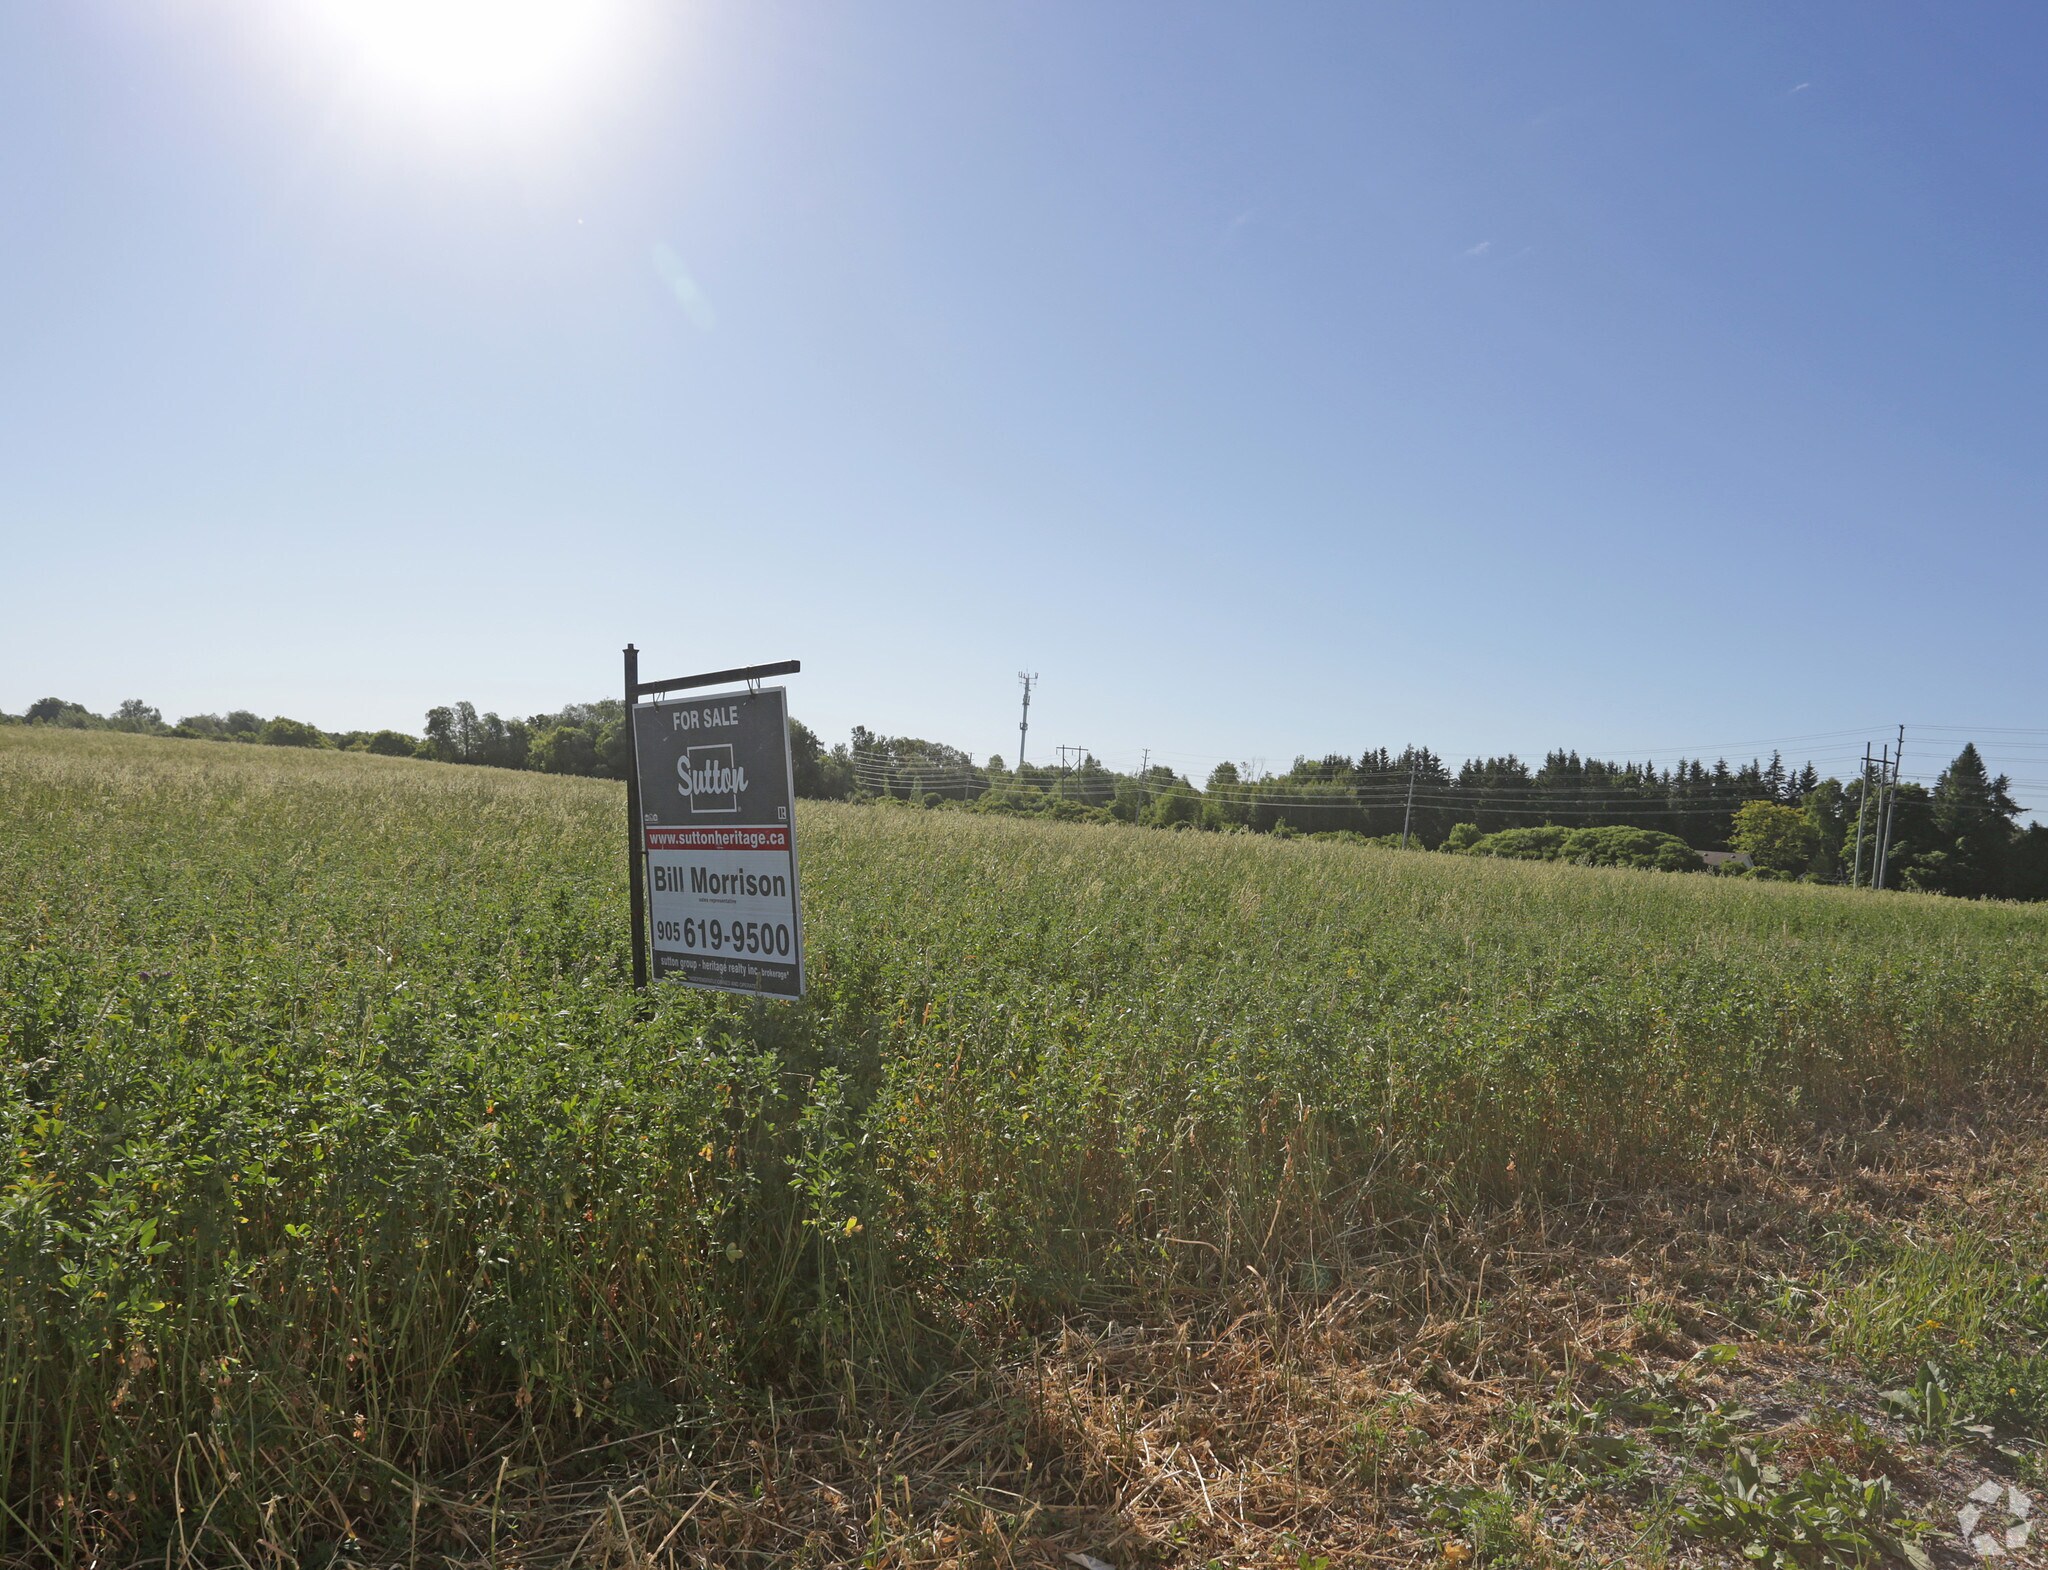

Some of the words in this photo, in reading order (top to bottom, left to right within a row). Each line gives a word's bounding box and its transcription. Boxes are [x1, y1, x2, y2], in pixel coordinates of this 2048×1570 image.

[672, 709, 700, 731] FOR
[703, 705, 739, 728] SALE
[677, 755, 749, 796] Sutton
[649, 830, 785, 848] www.suttonheritage.ca
[653, 865, 684, 893] Bill
[690, 866, 786, 897] Morrison
[657, 920, 681, 942] 905
[684, 917, 790, 957] 619-9500
[660, 957, 679, 968] sutton
[680, 959, 697, 971] group
[702, 959, 727, 974] heritage
[728, 963, 746, 976] realty
